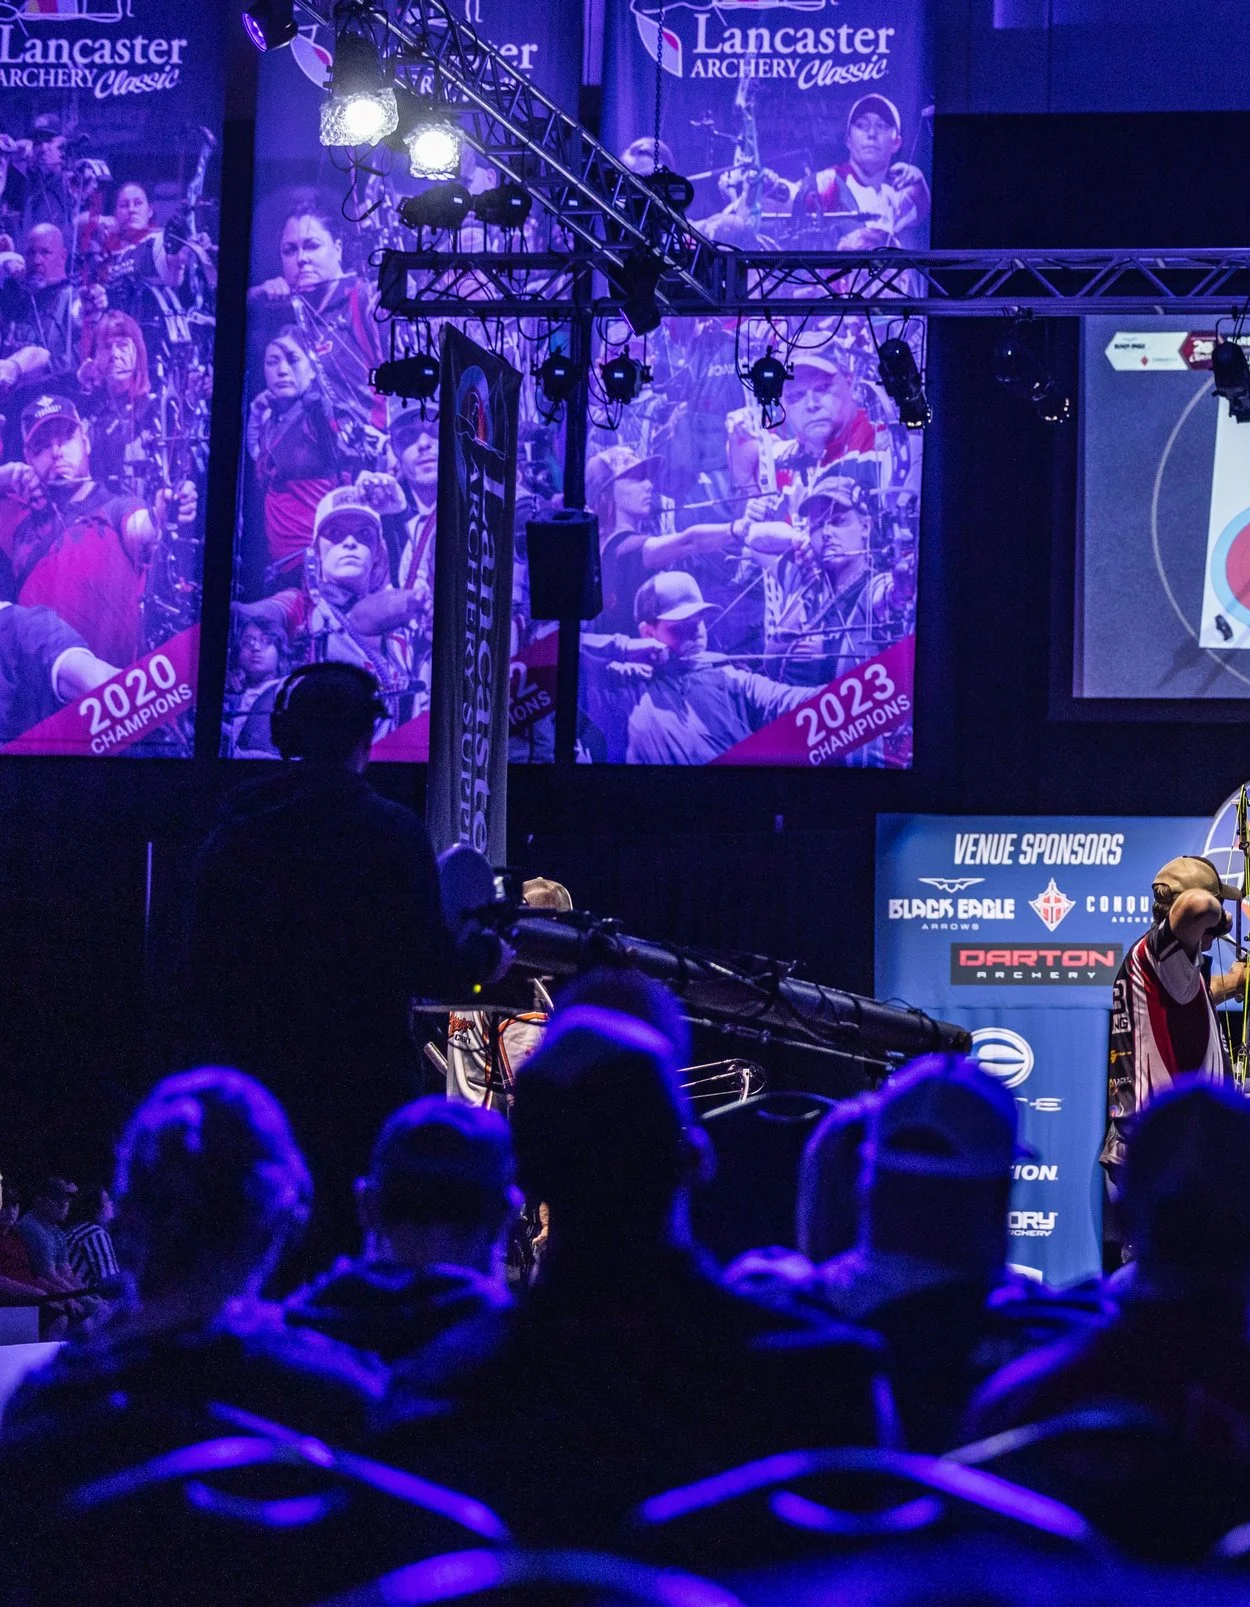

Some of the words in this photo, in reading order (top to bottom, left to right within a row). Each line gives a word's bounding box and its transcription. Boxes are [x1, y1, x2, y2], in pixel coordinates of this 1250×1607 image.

[0, 25, 188, 64] Lancaster
[693, 13, 895, 54] Lancaster
[0, 68, 97, 88] ARCHERY
[94, 65, 180, 99] Classic
[690, 58, 801, 78] ARCHERY
[797, 55, 887, 90] Classic
[473, 464, 506, 854] Lancaste
[79, 654, 177, 736] 2020
[795, 664, 895, 747] 2023
[91, 683, 192, 754] CHAMPIONS
[809, 694, 910, 766] CHAMPIONS
[459, 702, 474, 846] SUPP
[954, 834, 1017, 865] VENUE
[1019, 834, 1125, 865] SPONSORS
[889, 899, 954, 919] BLACK
[958, 899, 1015, 919] EAGLE
[1086, 896, 1149, 914] CONQU
[921, 923, 979, 931] ARROWS
[959, 950, 1115, 967] DARTON
[977, 971, 1096, 979] ARCHERY
